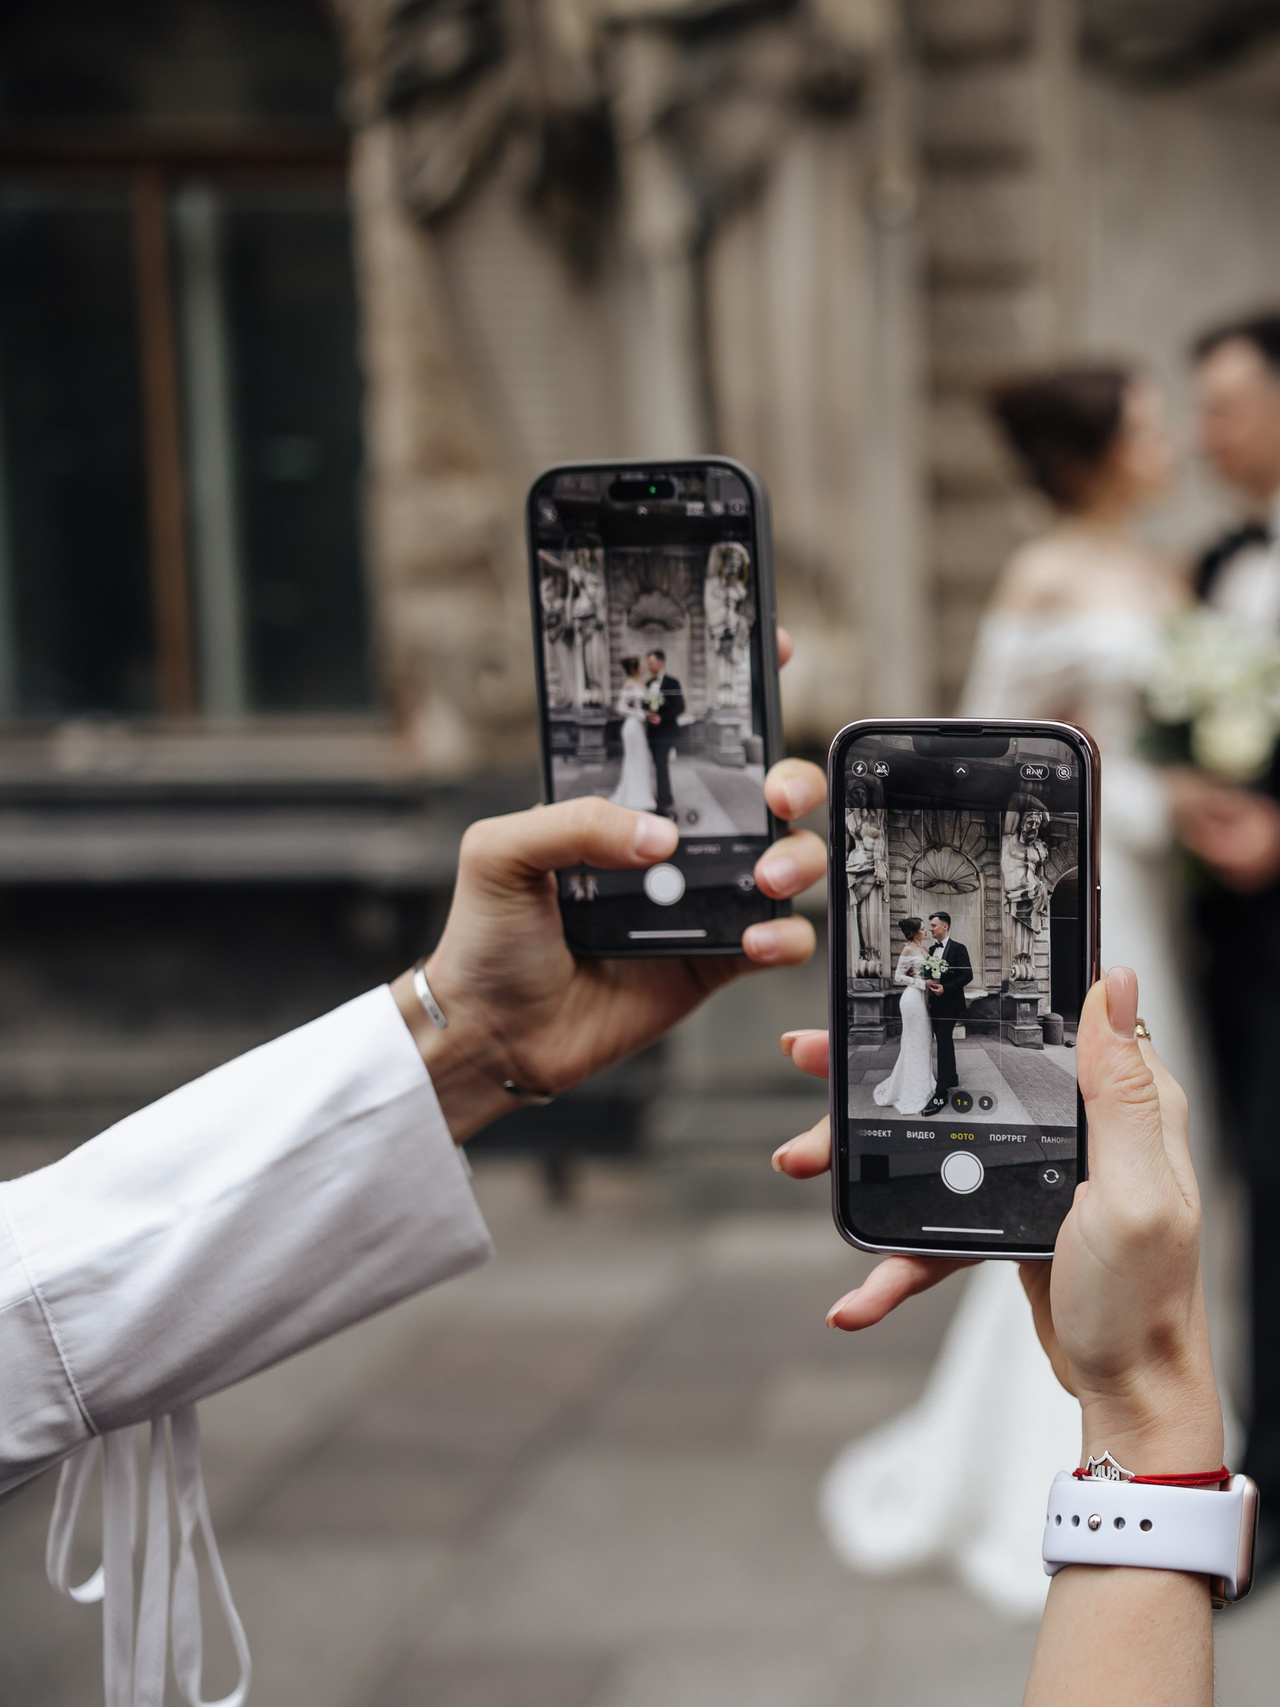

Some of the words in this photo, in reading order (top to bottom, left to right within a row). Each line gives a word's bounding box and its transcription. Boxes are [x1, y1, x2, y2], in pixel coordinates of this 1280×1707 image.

[933, 1098, 944, 1106] 0,5
[906, 1130, 936, 1140] ВИДЕО
[950, 1132, 975, 1141] ФОТО
[989, 1133, 1027, 1143] ПОРТРЕТ
